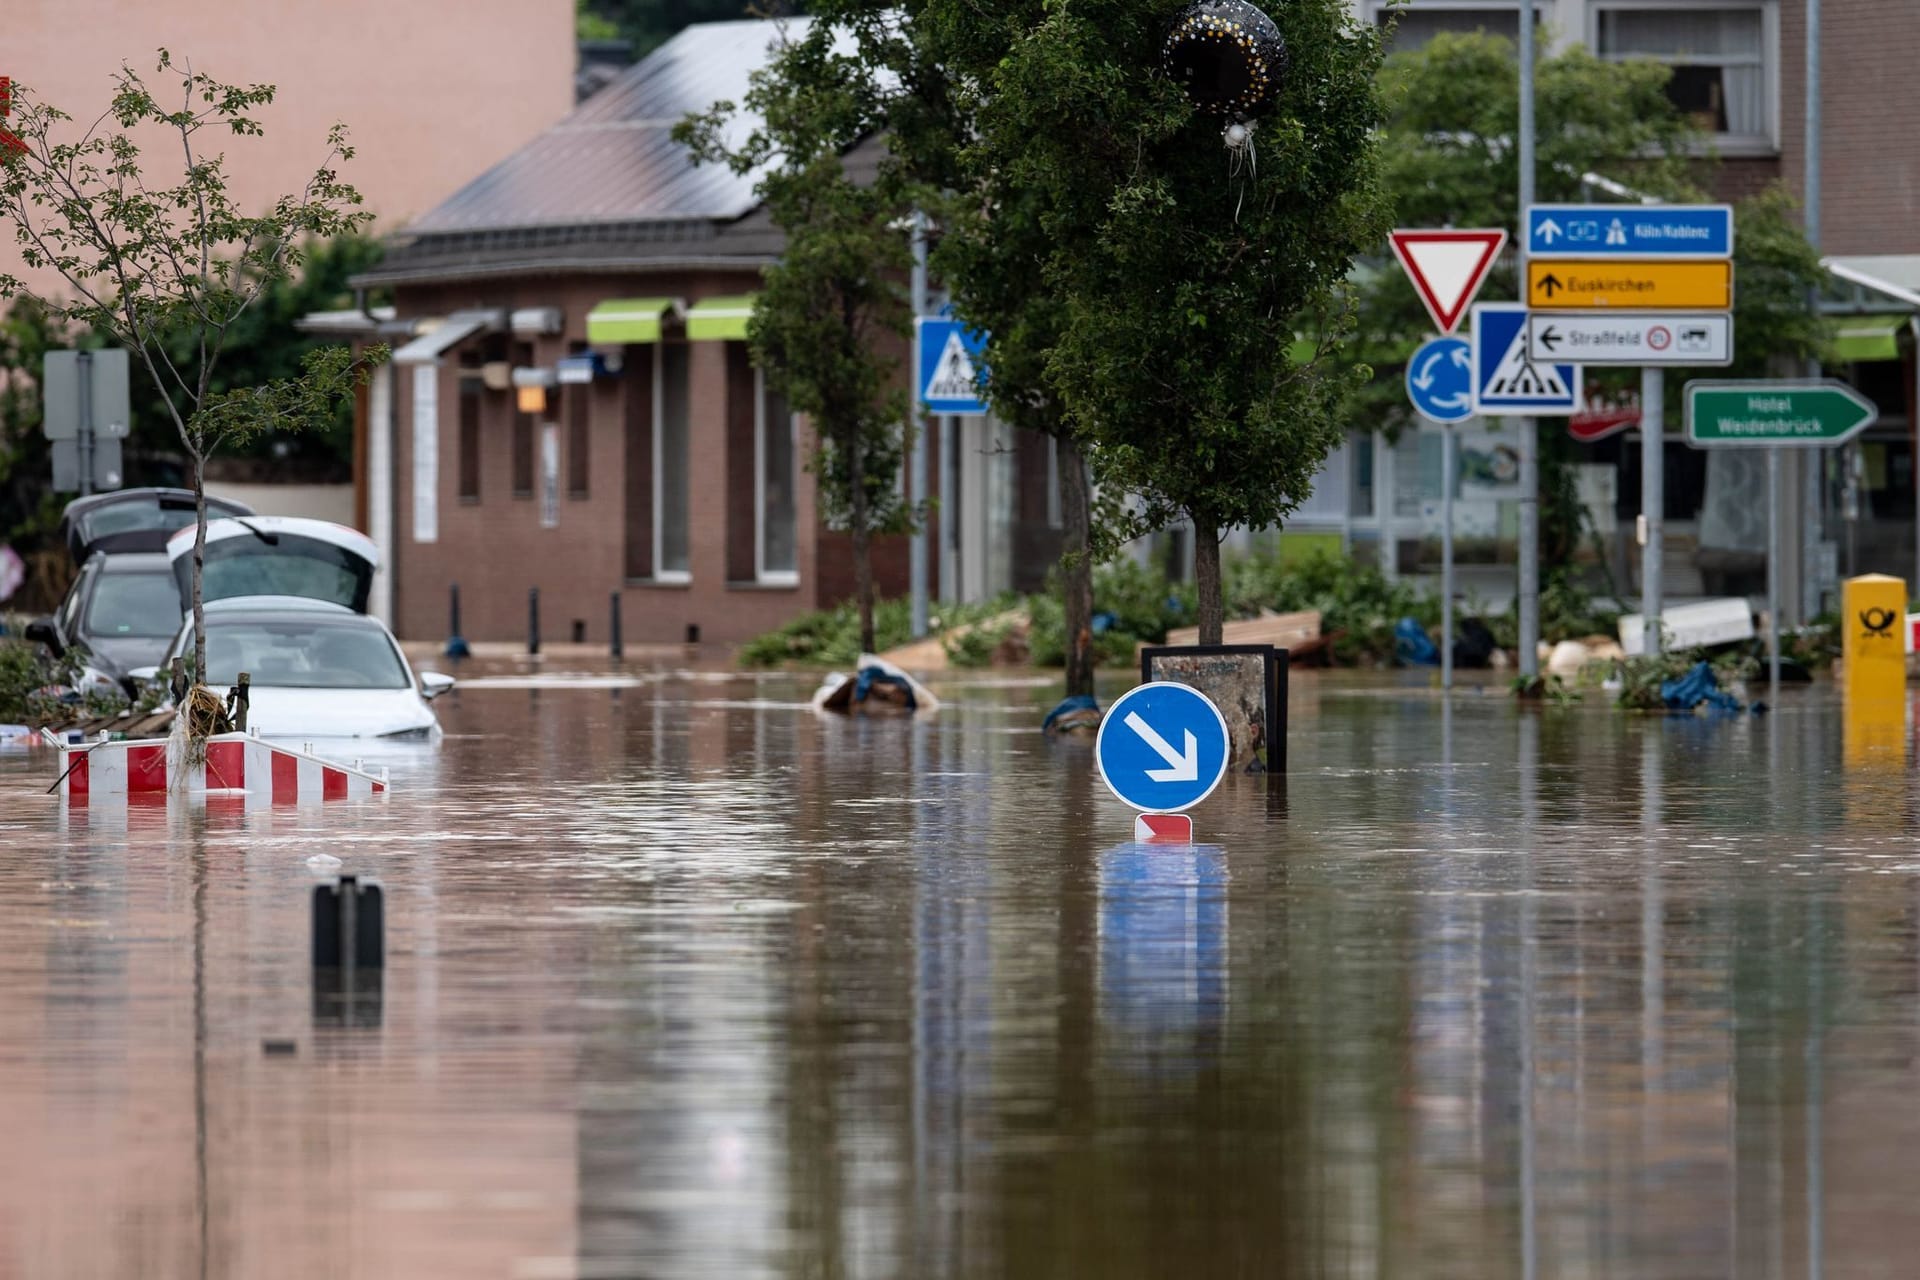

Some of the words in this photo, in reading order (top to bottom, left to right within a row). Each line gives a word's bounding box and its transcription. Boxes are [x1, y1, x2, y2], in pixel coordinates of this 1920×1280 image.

[1567, 277, 1655, 291] Euskirchen
[1569, 331, 1641, 346] Straßfeld
[1748, 397, 1792, 412] Hotel
[1717, 417, 1823, 434] Weidenbrück
